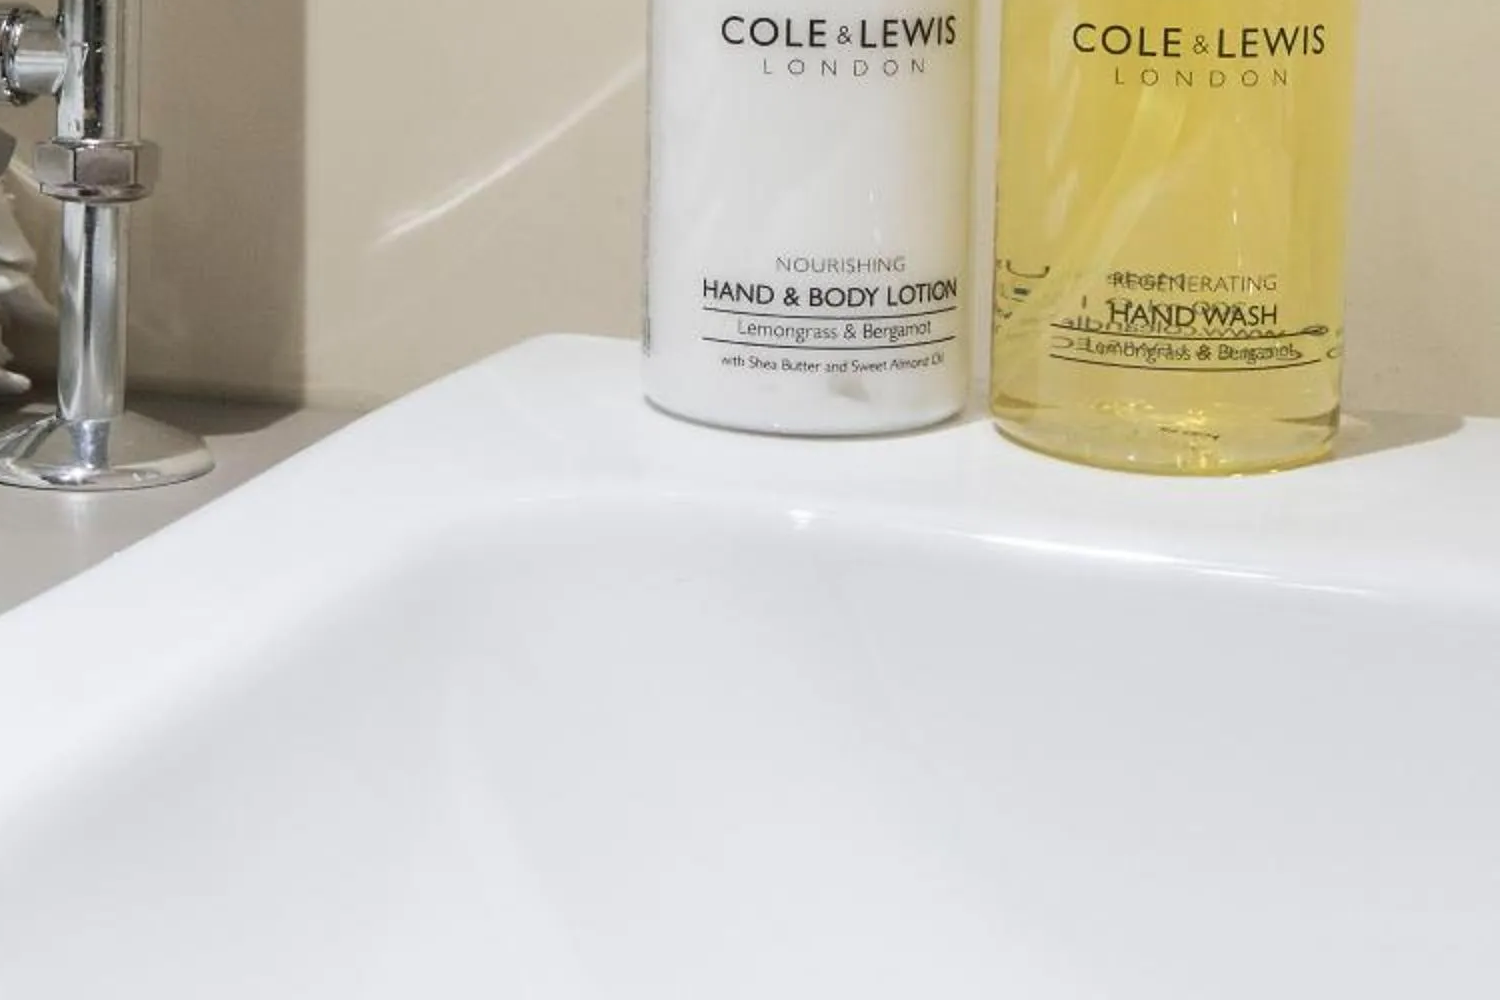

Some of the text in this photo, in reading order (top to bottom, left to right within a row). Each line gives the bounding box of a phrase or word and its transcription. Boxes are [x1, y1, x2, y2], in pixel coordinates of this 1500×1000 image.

[721, 15, 957, 48] COLE & LEWIS
[1072, 22, 1326, 58] COLE & LEWIS
[762, 57, 926, 77] LONDON
[1114, 66, 1288, 88] LONDON
[775, 256, 907, 273] NOURISHING
[702, 277, 958, 308] HAND & BODY LOTION
[1111, 271, 1277, 292] REGENERATING
[1110, 303, 1277, 327] HAND WASH
[737, 319, 932, 343] Lemongrass & Bergamot
[1196, 343, 1211, 361] &
[721, 355, 745, 367] with
[749, 355, 778, 370] Shea
[781, 359, 820, 373] Butter
[824, 359, 848, 373] and
[851, 359, 888, 374] Sweet
[890, 355, 929, 370] Almond
